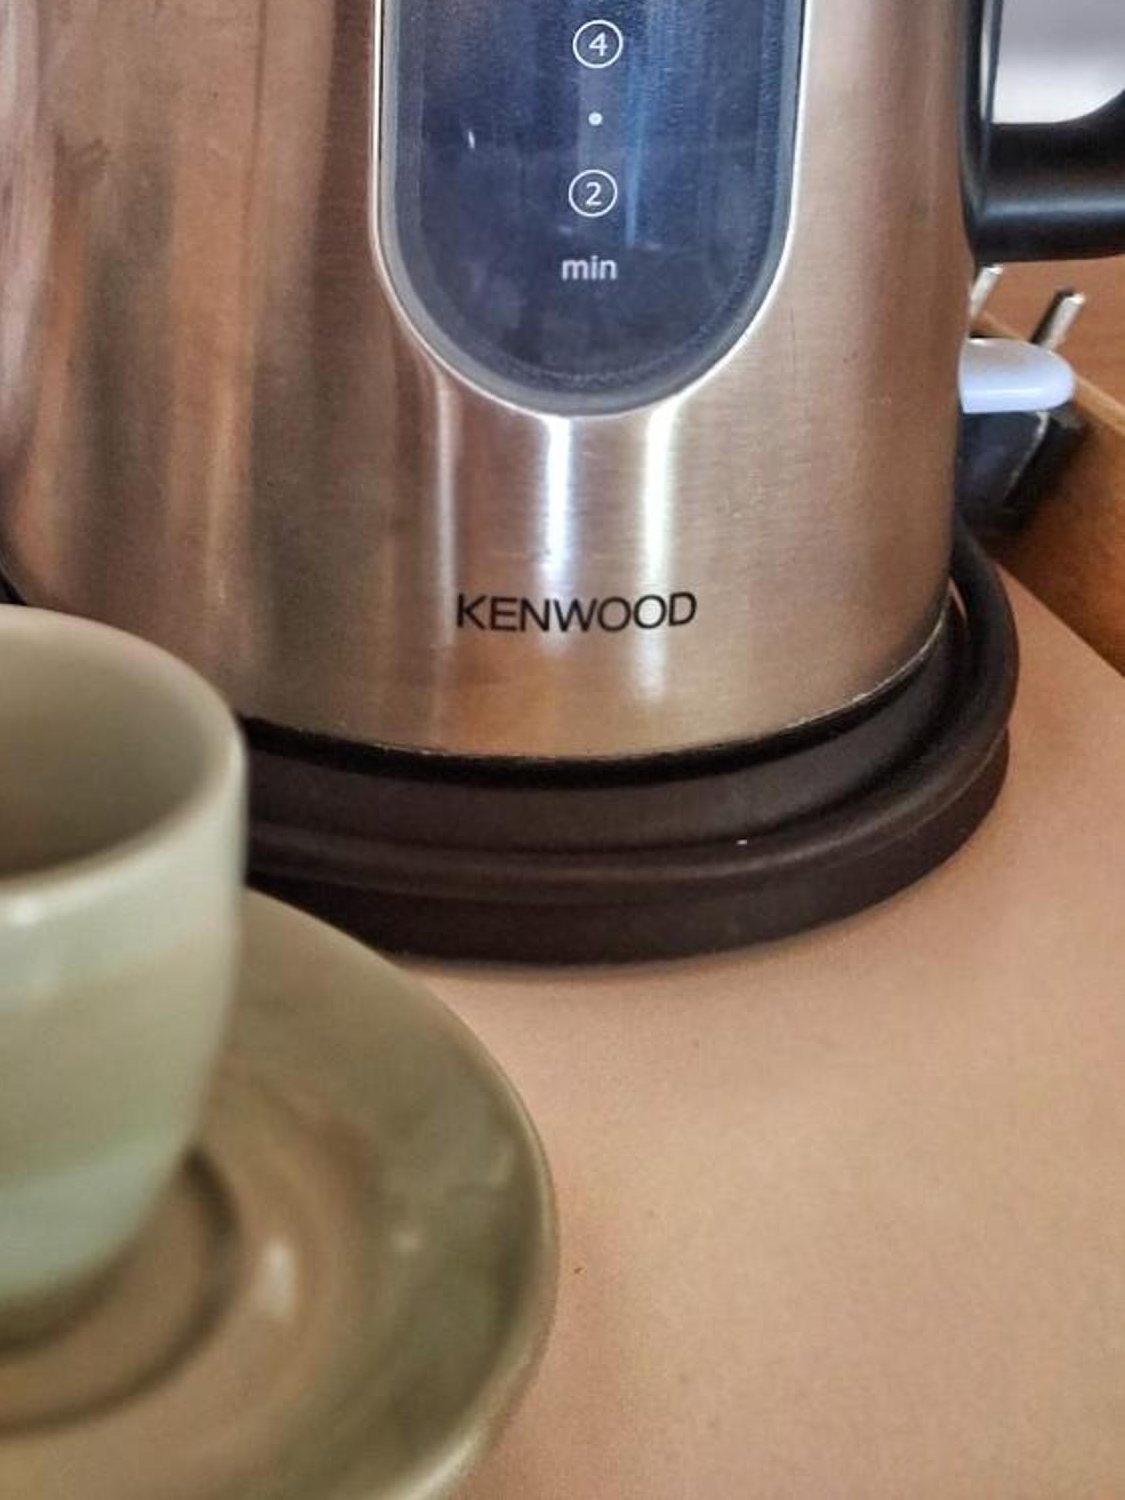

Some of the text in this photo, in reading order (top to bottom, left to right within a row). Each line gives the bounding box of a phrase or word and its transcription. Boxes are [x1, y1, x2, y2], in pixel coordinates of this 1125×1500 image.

[588, 32, 608, 57] 4
[585, 181, 603, 207] 2
[561, 256, 618, 280] min
[456, 591, 698, 633] KENWOOD
